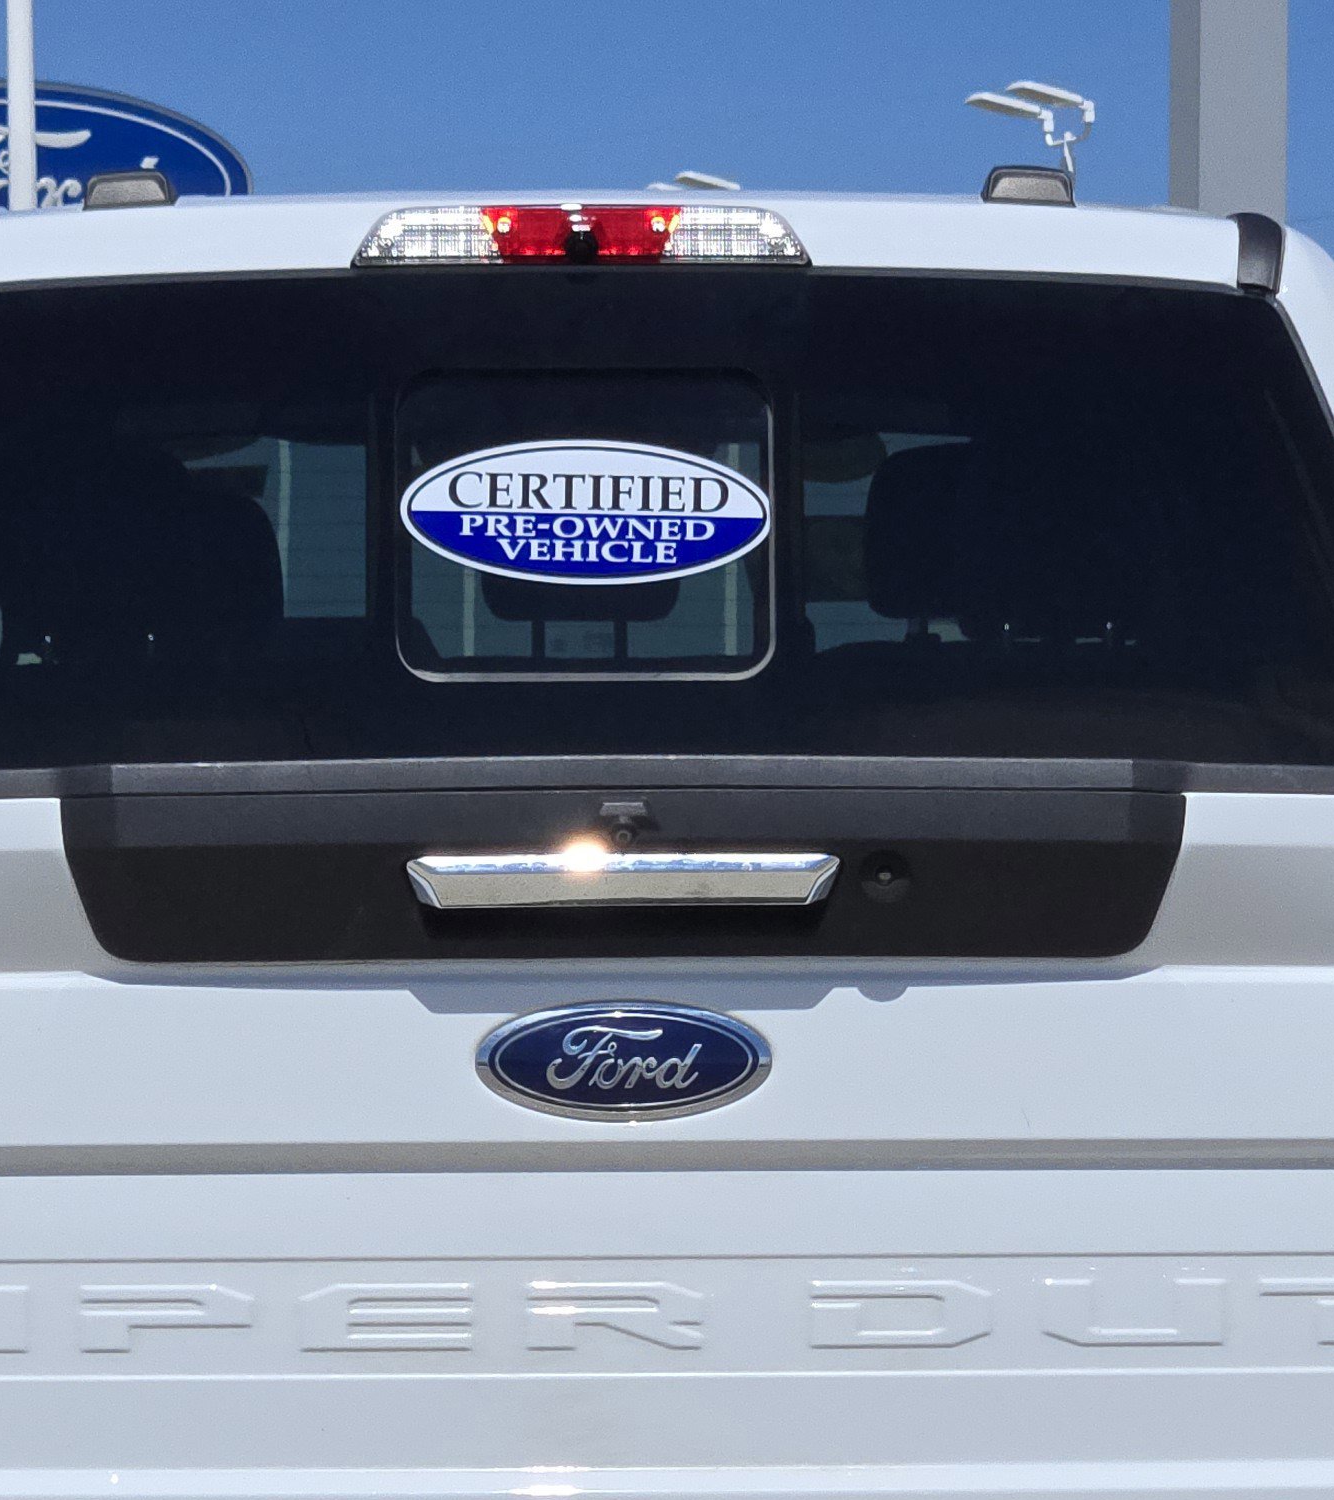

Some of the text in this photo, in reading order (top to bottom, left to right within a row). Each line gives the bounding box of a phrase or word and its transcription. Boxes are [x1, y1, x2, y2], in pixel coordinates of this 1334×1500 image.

[448, 471, 730, 514] CERTIFIED
[459, 514, 716, 542] PRE-OWNED
[497, 538, 678, 565] VEHICLE
[546, 1025, 703, 1090] Ford
